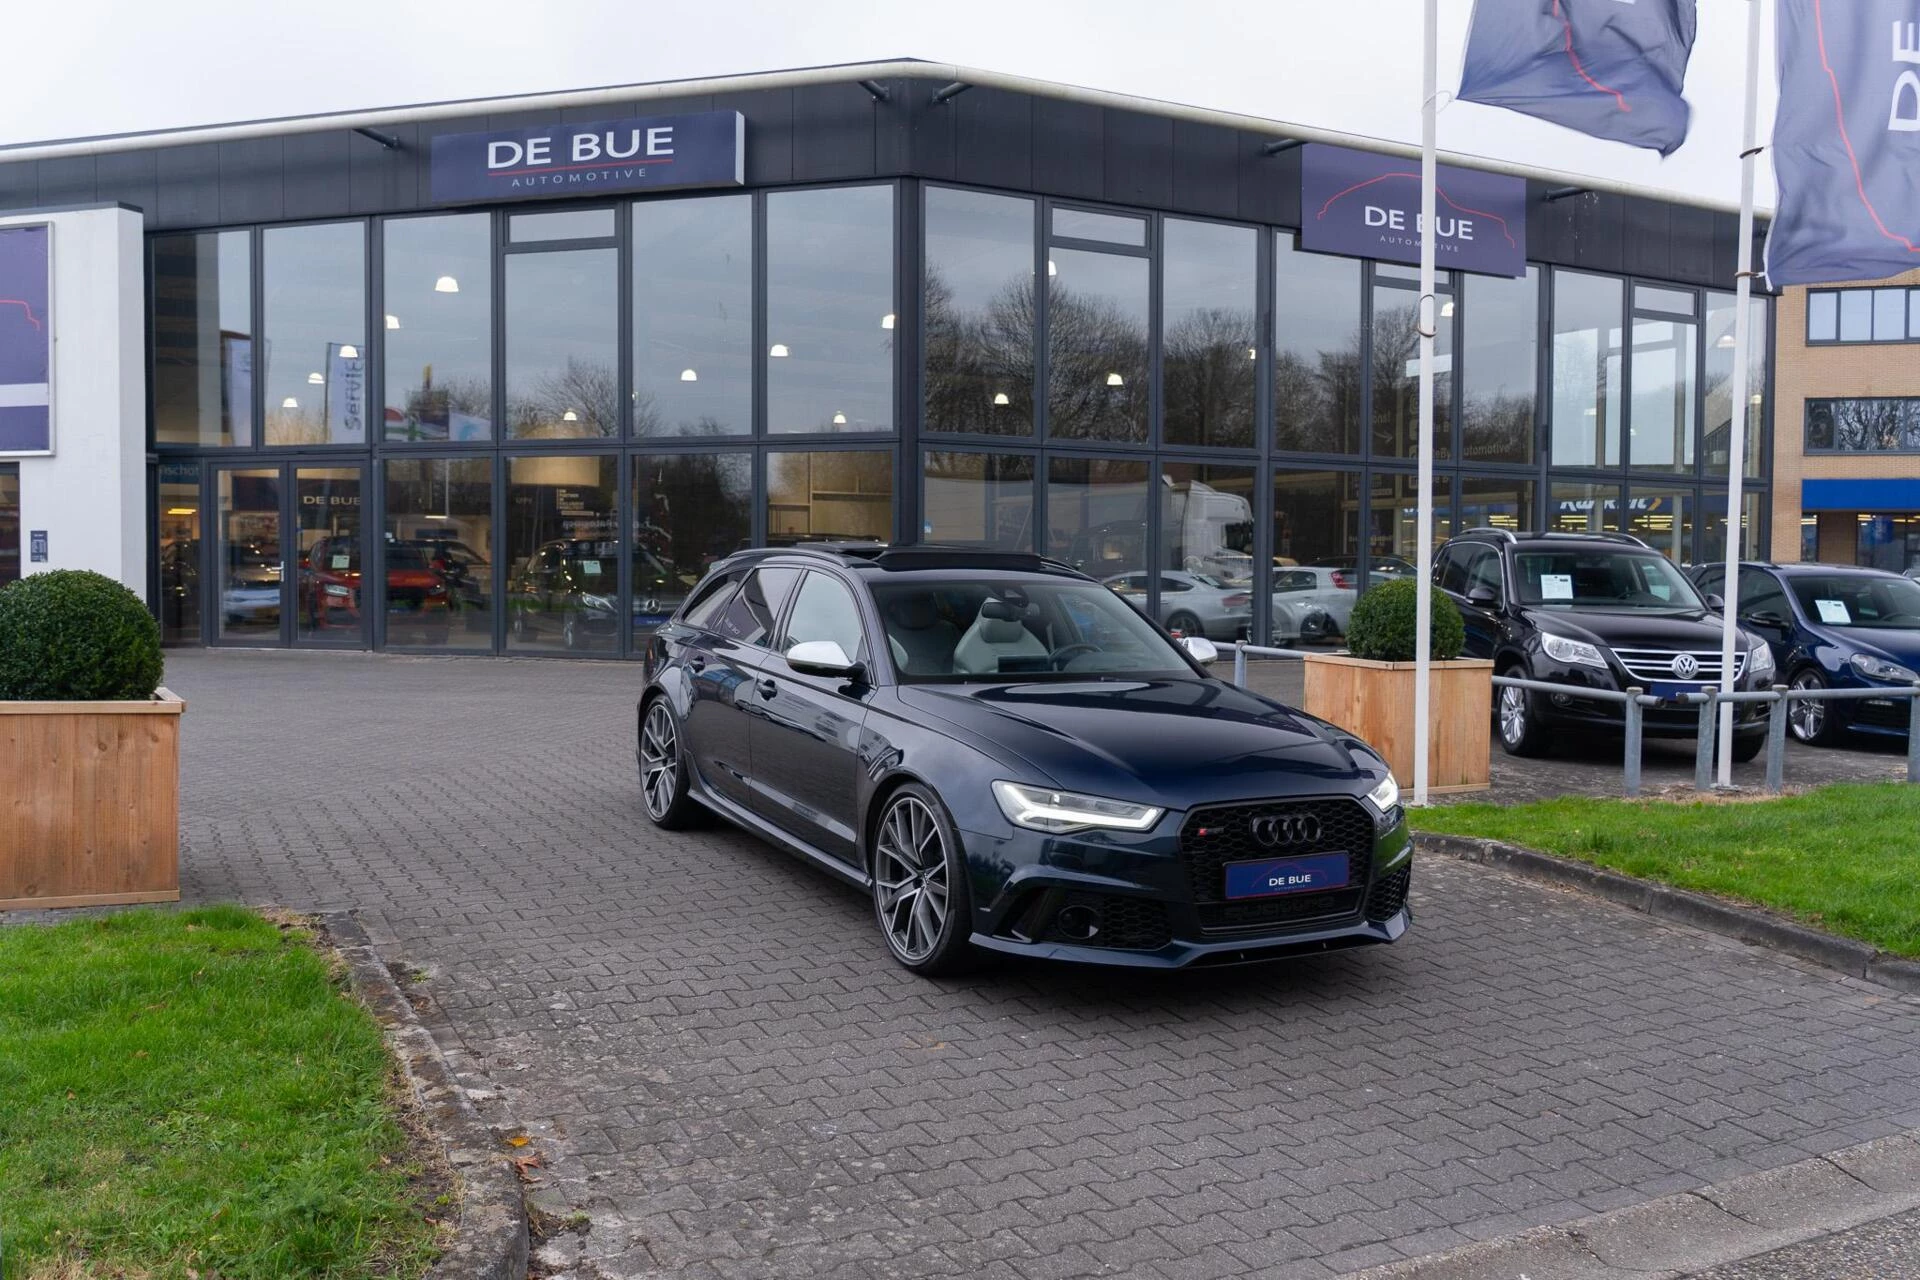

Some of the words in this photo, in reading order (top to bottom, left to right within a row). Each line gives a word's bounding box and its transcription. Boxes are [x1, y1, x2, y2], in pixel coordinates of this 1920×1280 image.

[1887, 20, 1920, 132] DE
[487, 136, 552, 169] DE
[571, 126, 674, 162] BUE
[511, 167, 647, 188] AUTOMOTIVE
[1364, 205, 1405, 230] DE
[1379, 234, 1459, 253] AUTOMIVE
[303, 495, 325, 505] DE
[1268, 876, 1285, 887] DE
[1288, 874, 1312, 885] BUE
